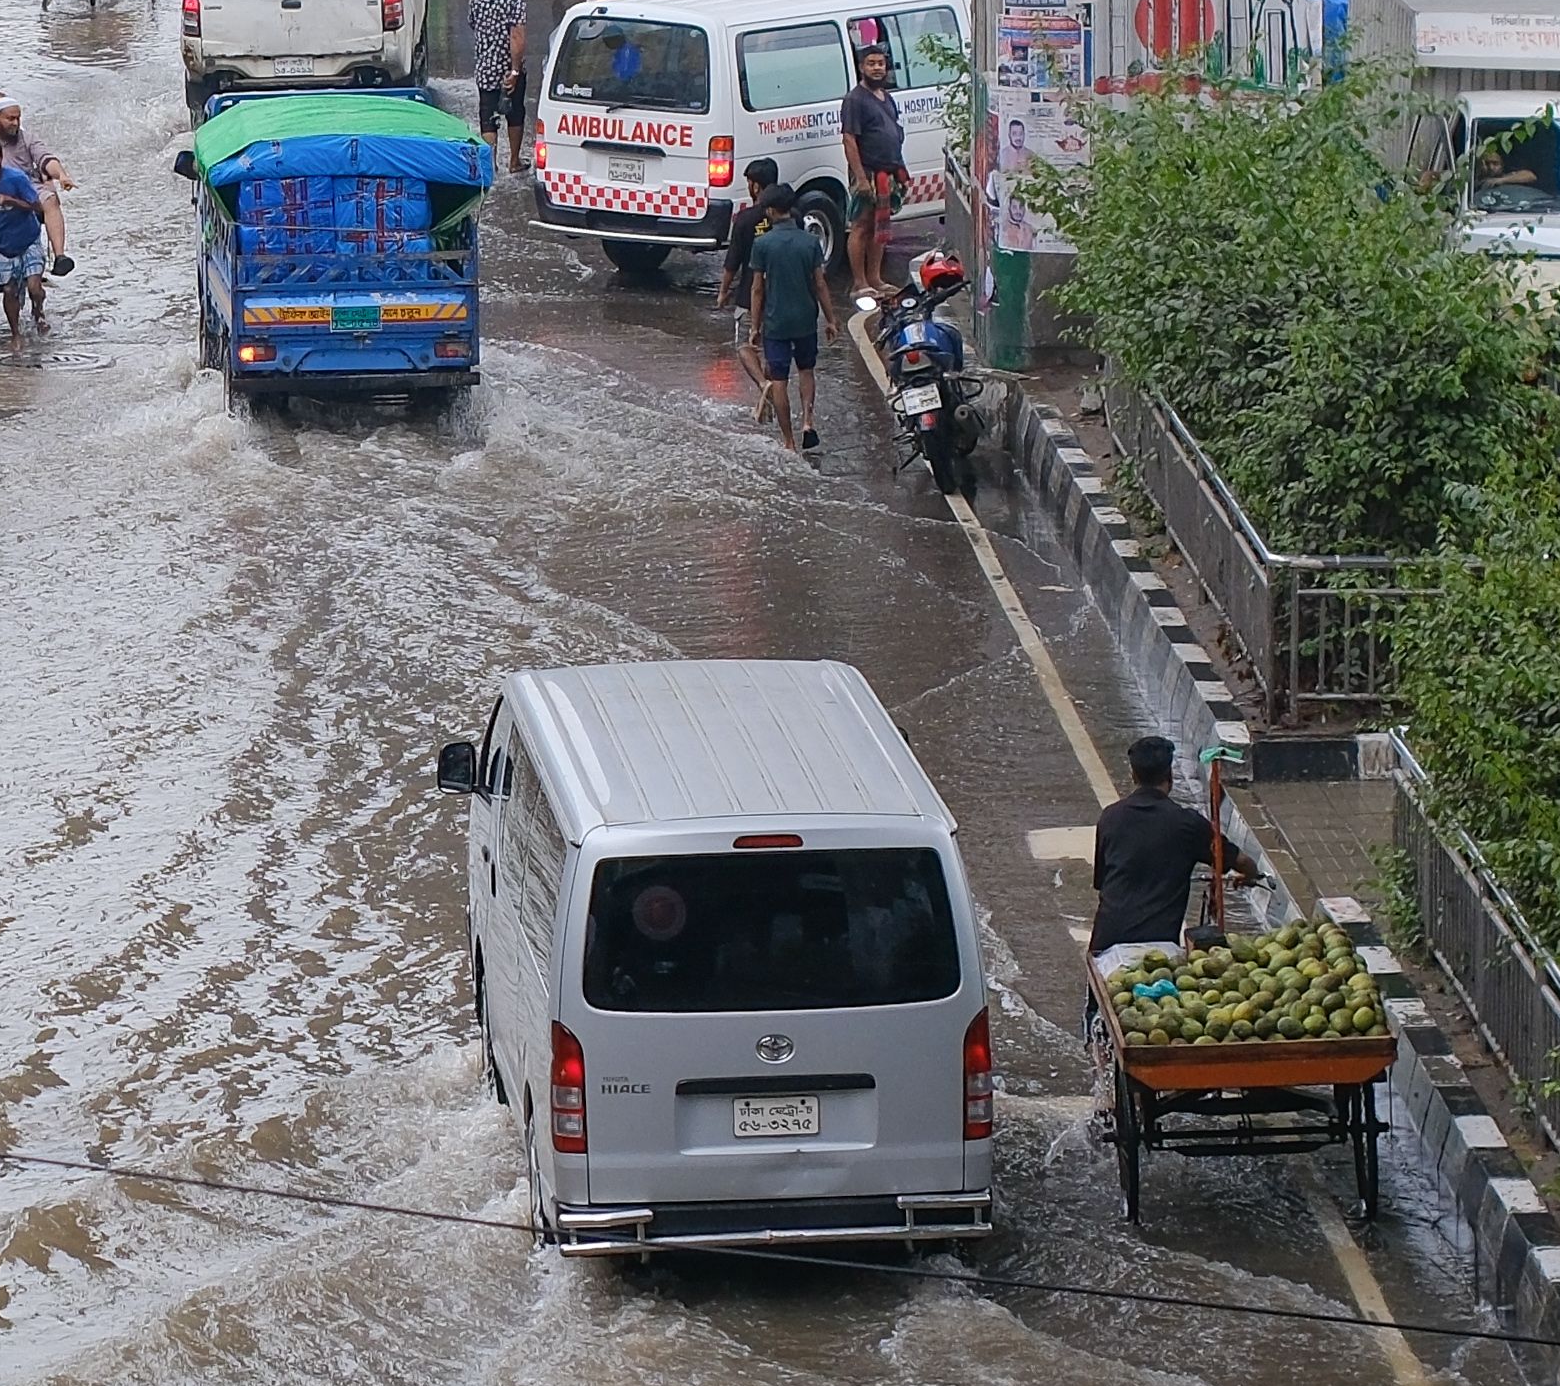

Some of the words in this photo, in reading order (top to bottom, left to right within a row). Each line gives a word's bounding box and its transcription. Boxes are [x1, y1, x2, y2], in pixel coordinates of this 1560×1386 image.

[904, 97, 944, 115] HOSPITAL
[758, 120, 775, 135] THE
[826, 110, 840, 125] CLI
[557, 114, 693, 148] AMBULANCE
[601, 1084, 651, 1094] HIACE
[739, 1107, 765, 1117] ঢাকা
[738, 1118, 812, 1132] ৫৬-৩২৭৫
